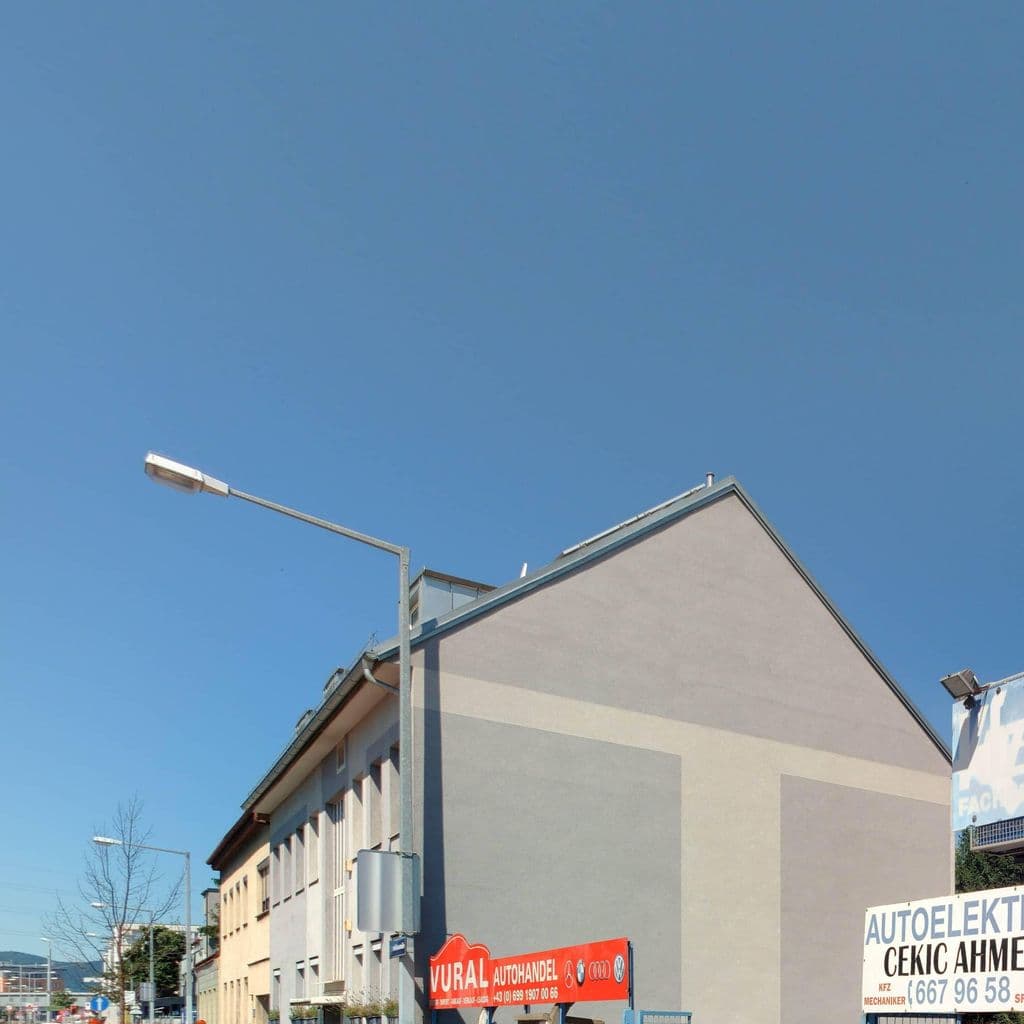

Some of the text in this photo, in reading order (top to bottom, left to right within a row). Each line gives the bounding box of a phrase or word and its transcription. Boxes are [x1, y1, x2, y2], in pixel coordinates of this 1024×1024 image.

[493, 959, 558, 986] AUTOHANDEL
[884, 942, 948, 977] CEKIC
[430, 958, 489, 993] VURAL
[878, 983, 891, 992] KFZ
[864, 996, 906, 1006] MECHANIKER
[954, 977, 978, 1004] 96
[984, 976, 1010, 1003] 58
